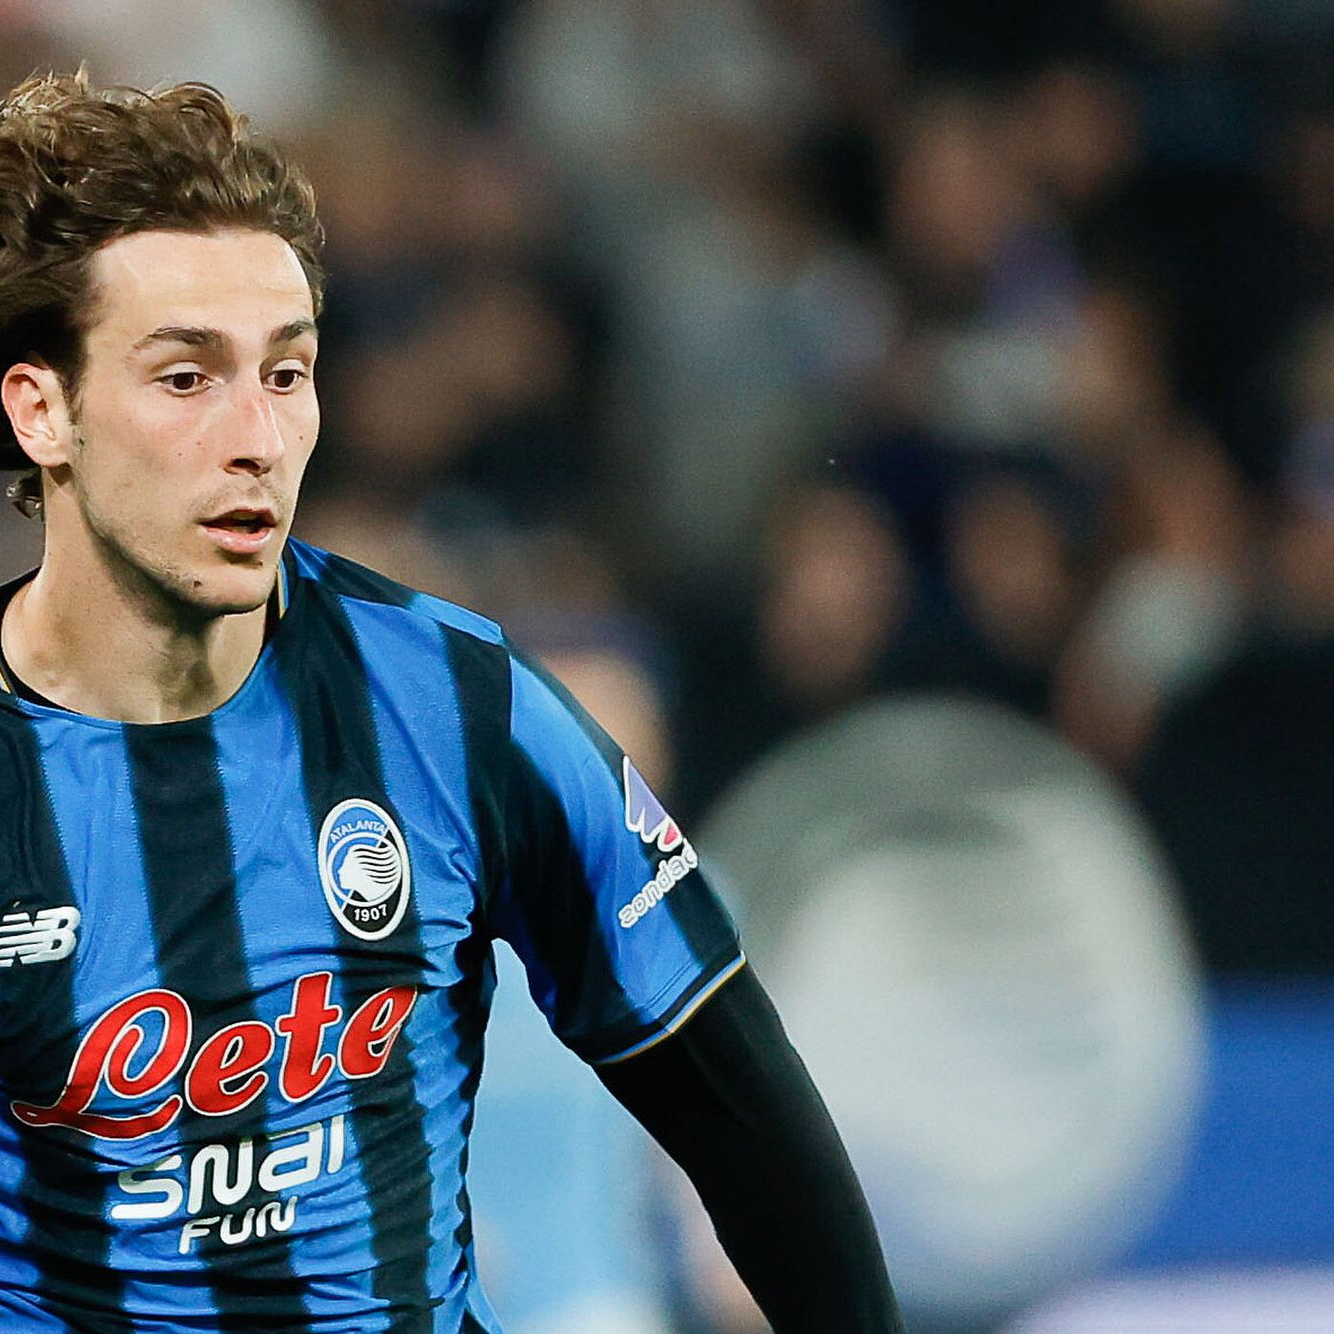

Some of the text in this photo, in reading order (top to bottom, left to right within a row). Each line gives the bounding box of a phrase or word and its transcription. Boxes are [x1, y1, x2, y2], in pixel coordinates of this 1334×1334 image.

[330, 820, 388, 843] ATALANTA
[354, 904, 387, 922] 1907
[11, 971, 418, 1140] Lete
[178, 1195, 299, 1254] FUN
